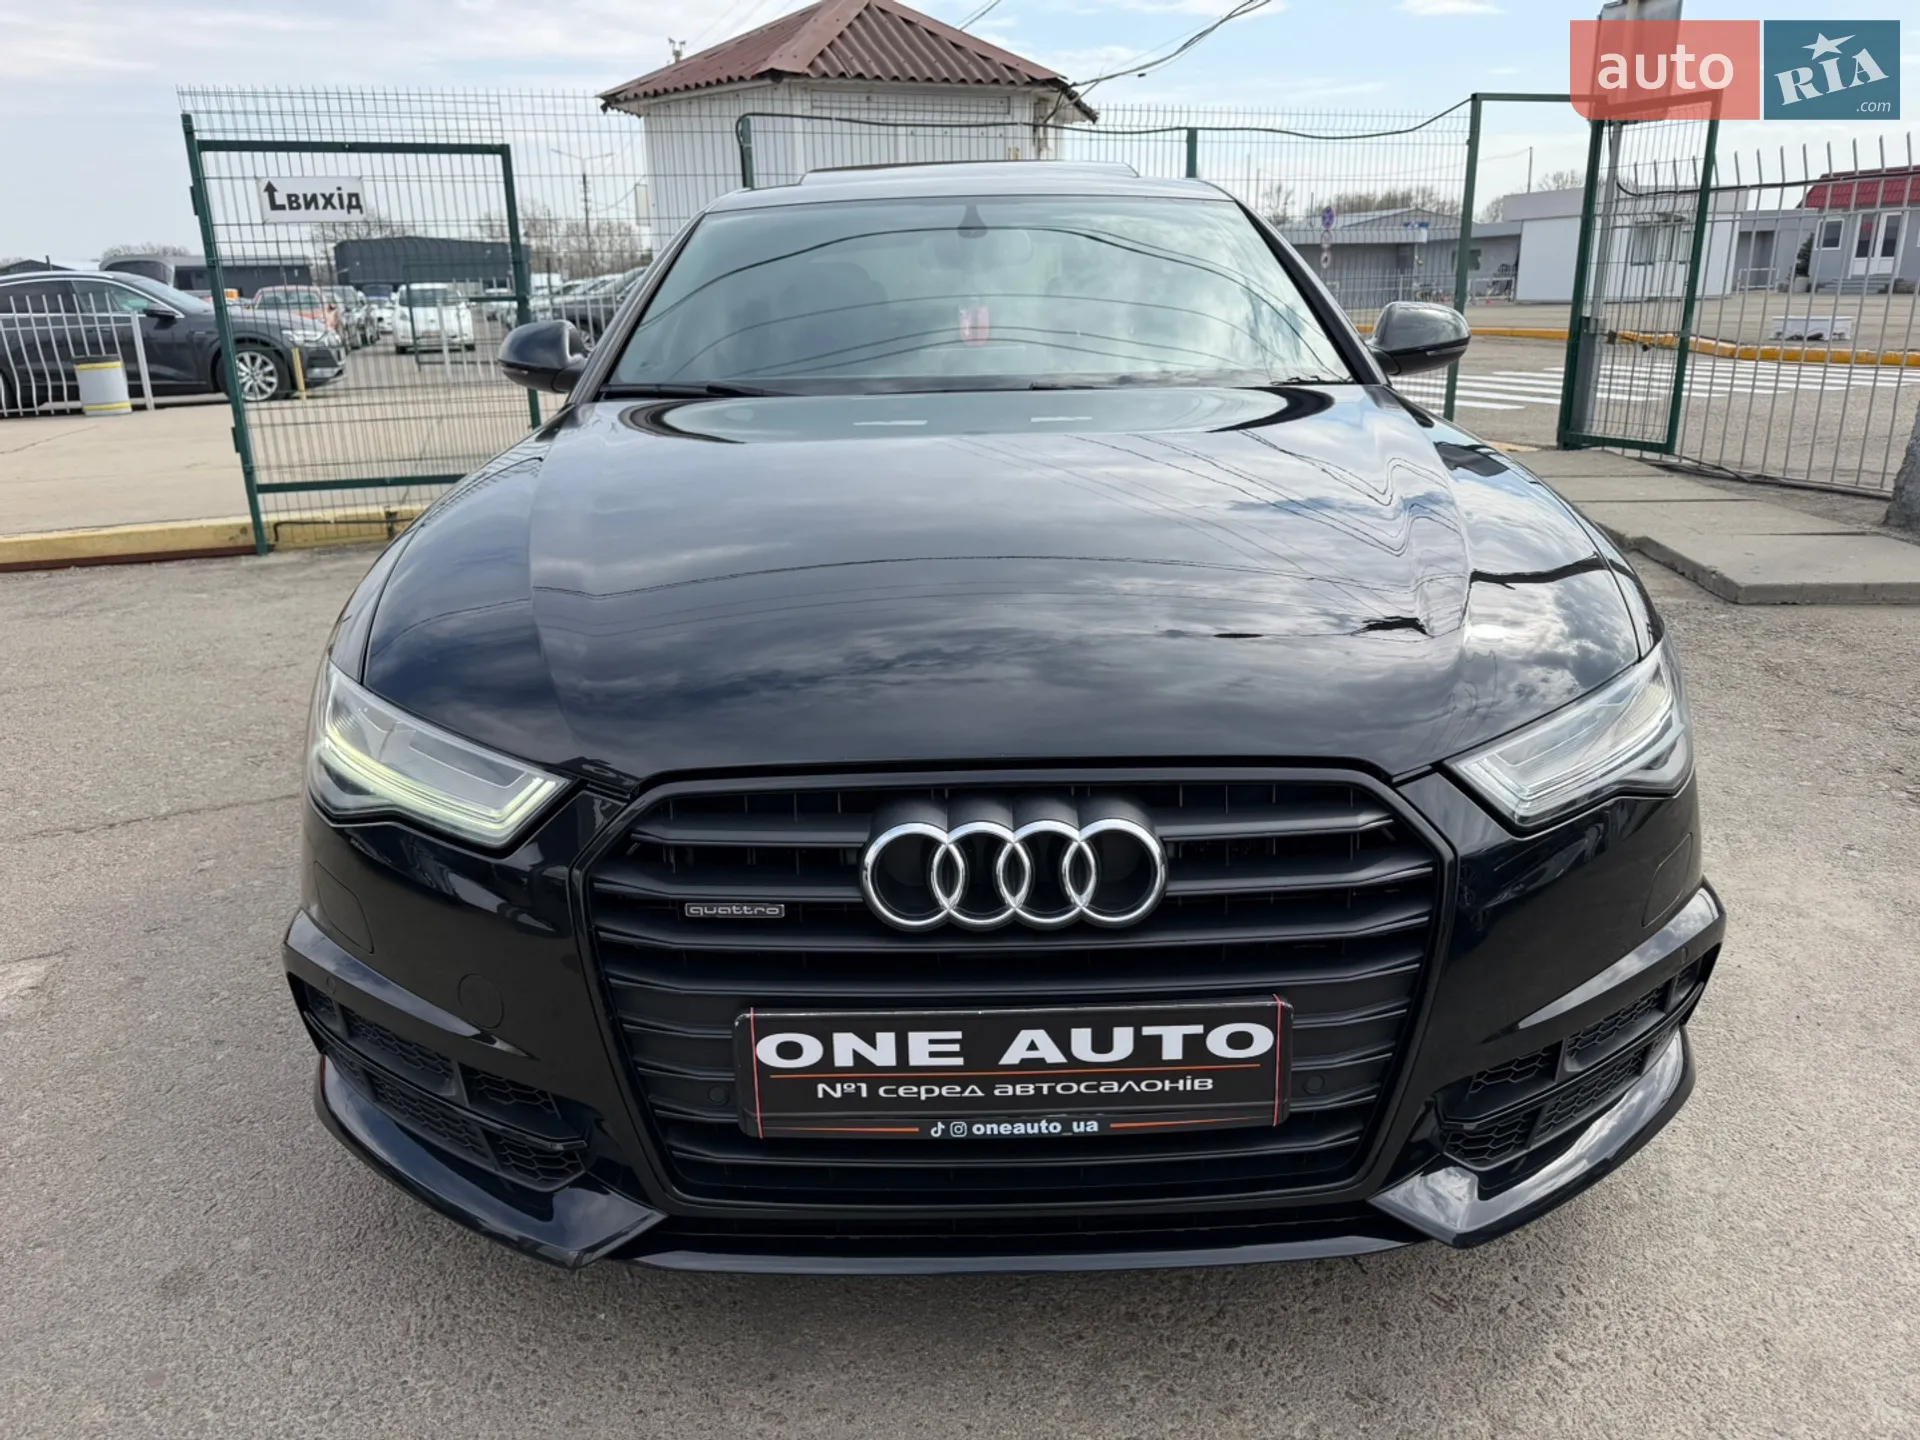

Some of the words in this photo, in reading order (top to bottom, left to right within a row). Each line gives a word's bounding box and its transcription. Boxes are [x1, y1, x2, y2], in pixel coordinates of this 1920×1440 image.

[286, 186, 364, 215] вихід
[689, 905, 780, 916] quattro
[755, 1031, 965, 1068] ONE
[998, 1022, 1275, 1065] AUTO
[878, 1083, 985, 1101] серед
[993, 1075, 1214, 1097] автосалонів
[972, 1119, 1099, 1137] oneauto_ua
